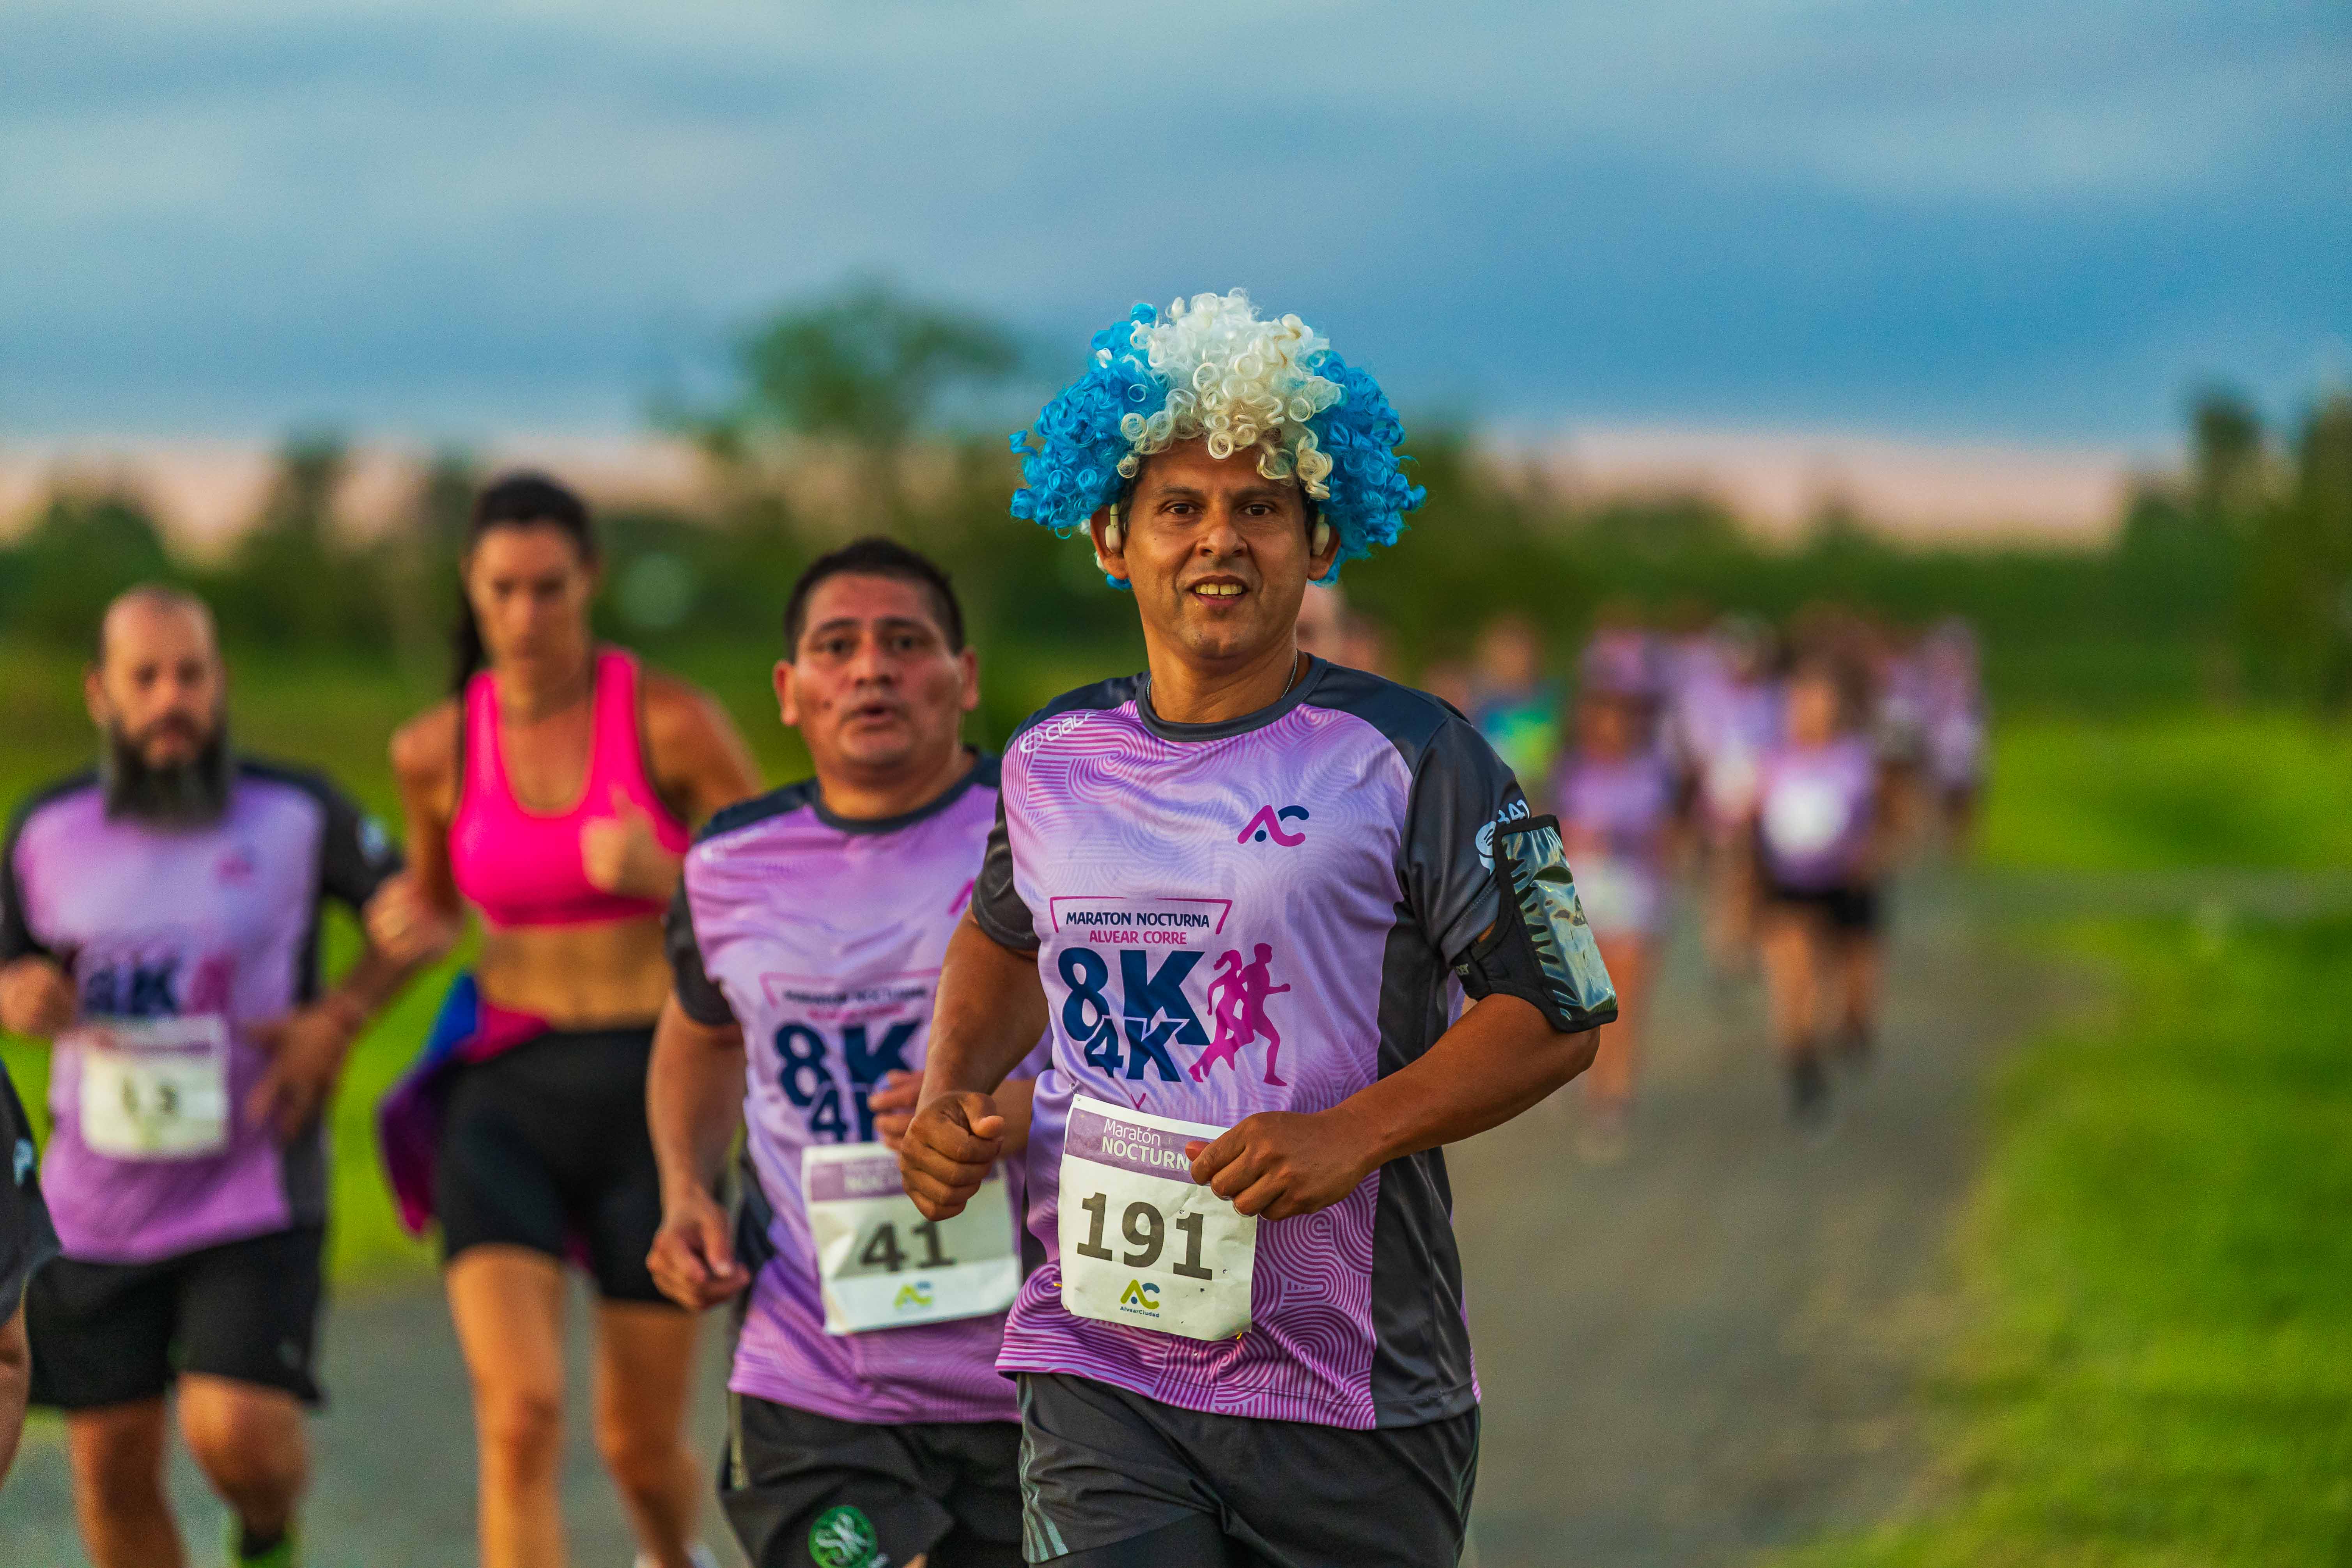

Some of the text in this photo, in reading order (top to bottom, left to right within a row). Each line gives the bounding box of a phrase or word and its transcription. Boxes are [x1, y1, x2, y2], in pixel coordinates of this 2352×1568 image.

[1066, 911, 1210, 928] MARATON NOCTURNA
[1089, 930, 1187, 945] ALVEAR CORRE
[1057, 947, 1211, 1046] 8K
[1084, 1019, 1182, 1082] 4K
[1102, 1136, 1191, 1171] NOCTURN
[1103, 1118, 1160, 1146] Maratón
[860, 1220, 958, 1273] 41
[1077, 1192, 1213, 1281] 191
